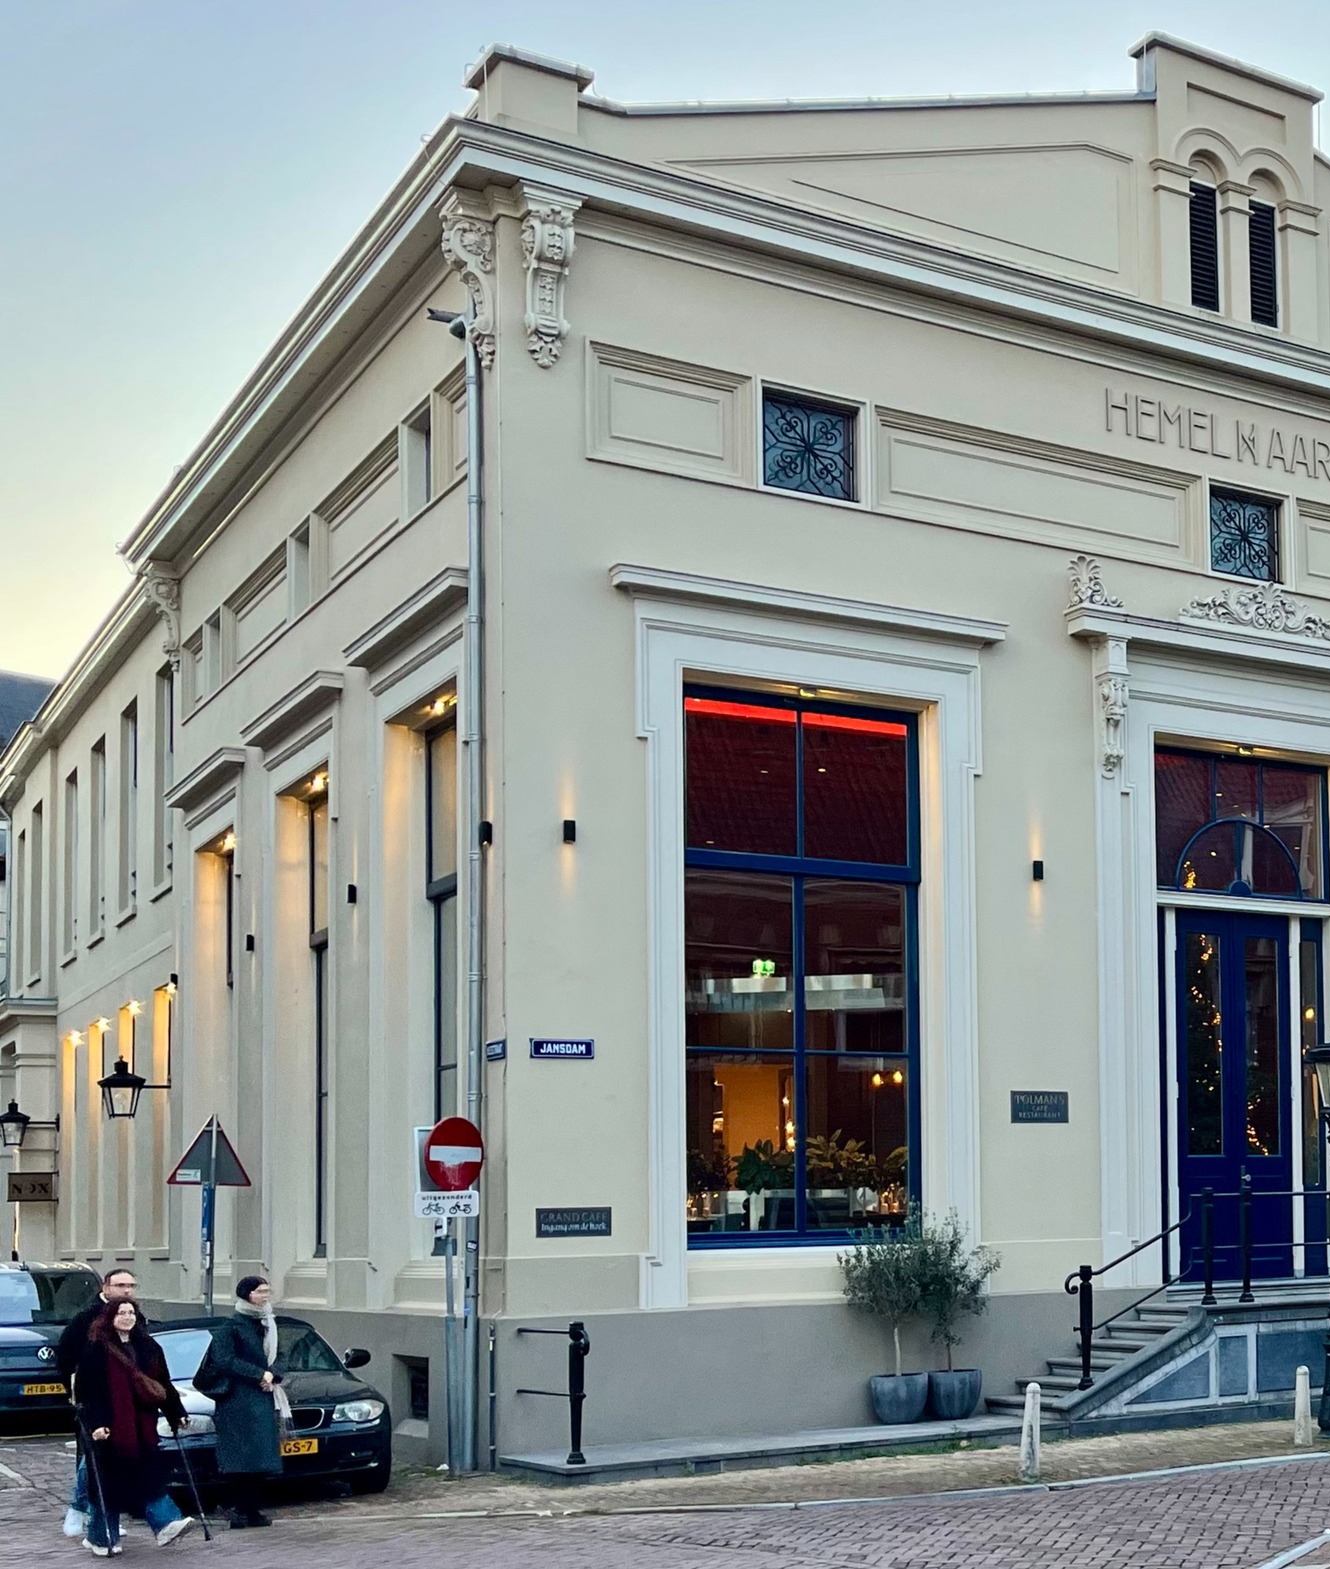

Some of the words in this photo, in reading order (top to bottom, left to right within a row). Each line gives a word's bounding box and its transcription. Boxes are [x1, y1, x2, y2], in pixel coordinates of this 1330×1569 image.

[1105, 387, 1231, 460] HEMEL
[540, 1043, 586, 1054] JANSDAM
[540, 1212, 580, 1223] GRAND
